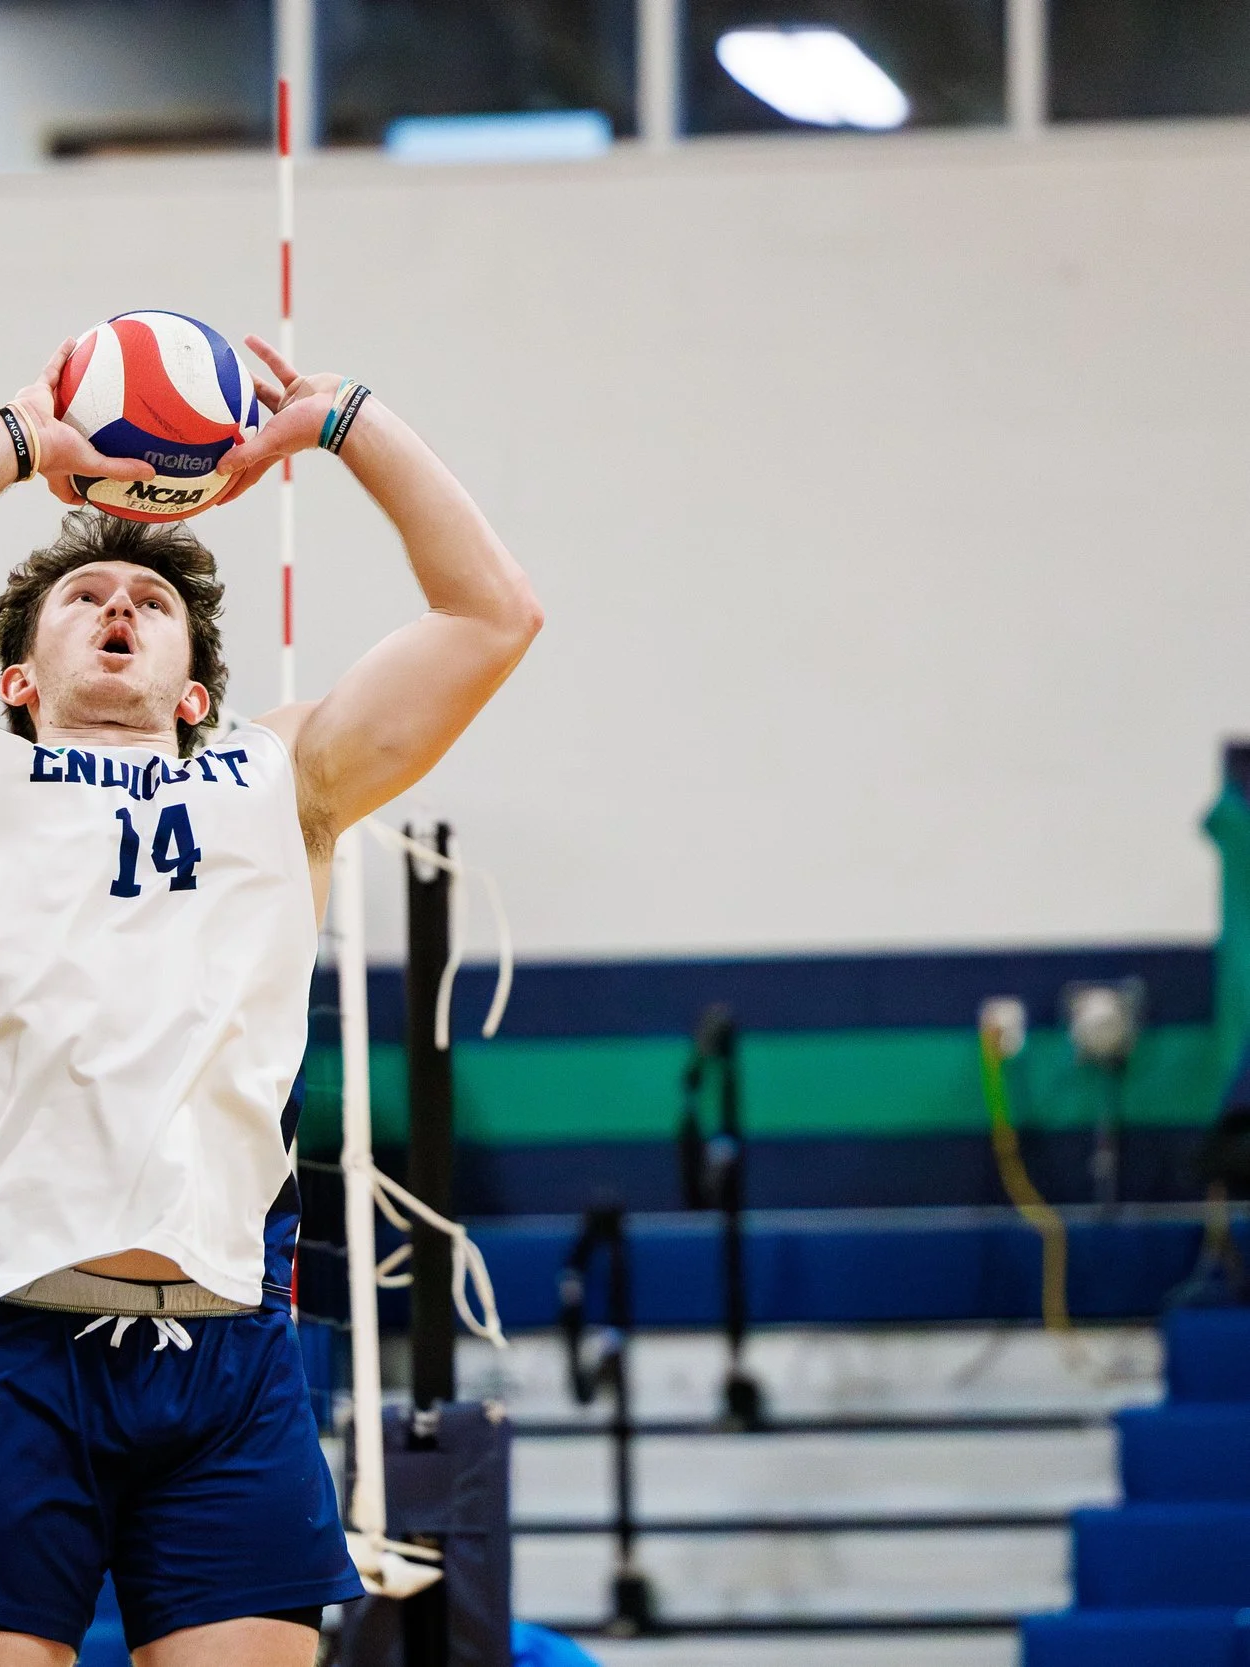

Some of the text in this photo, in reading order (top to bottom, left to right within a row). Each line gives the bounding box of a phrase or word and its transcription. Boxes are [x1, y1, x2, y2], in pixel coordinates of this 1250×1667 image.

[9, 422, 26, 456] NOVUS
[143, 450, 213, 472] molten
[125, 481, 205, 505] NCAA
[110, 803, 202, 898] 14
